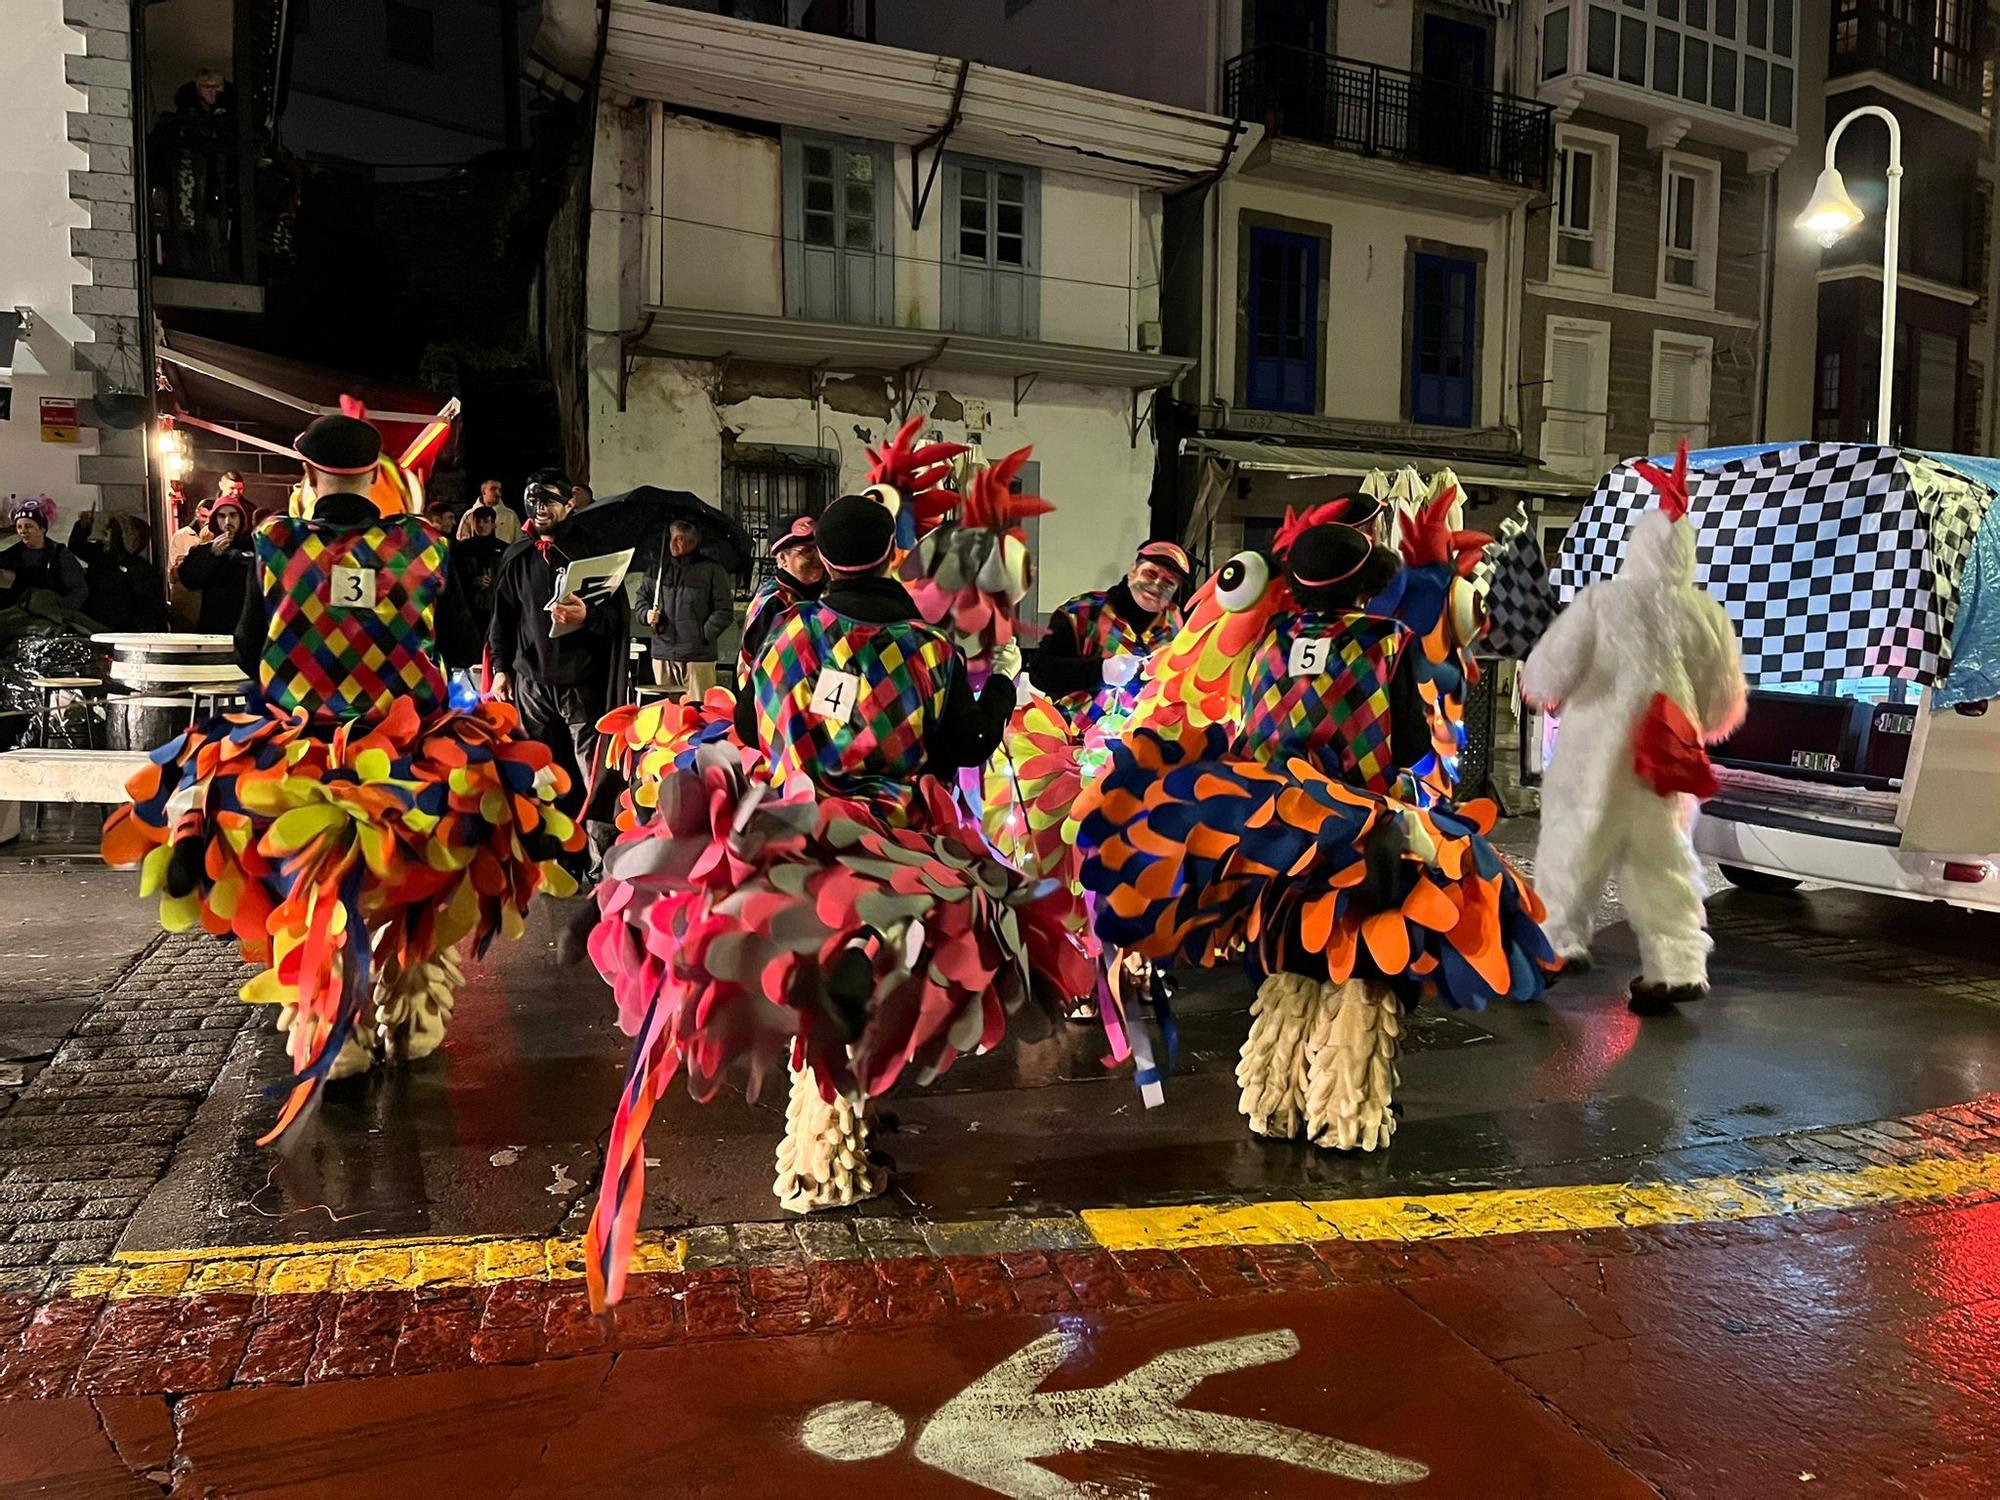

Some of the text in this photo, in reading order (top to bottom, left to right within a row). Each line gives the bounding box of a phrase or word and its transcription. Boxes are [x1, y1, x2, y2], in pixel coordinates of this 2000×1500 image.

[344, 576, 363, 601] 3
[1301, 645, 1316, 669] 5
[824, 682, 843, 712] 4
